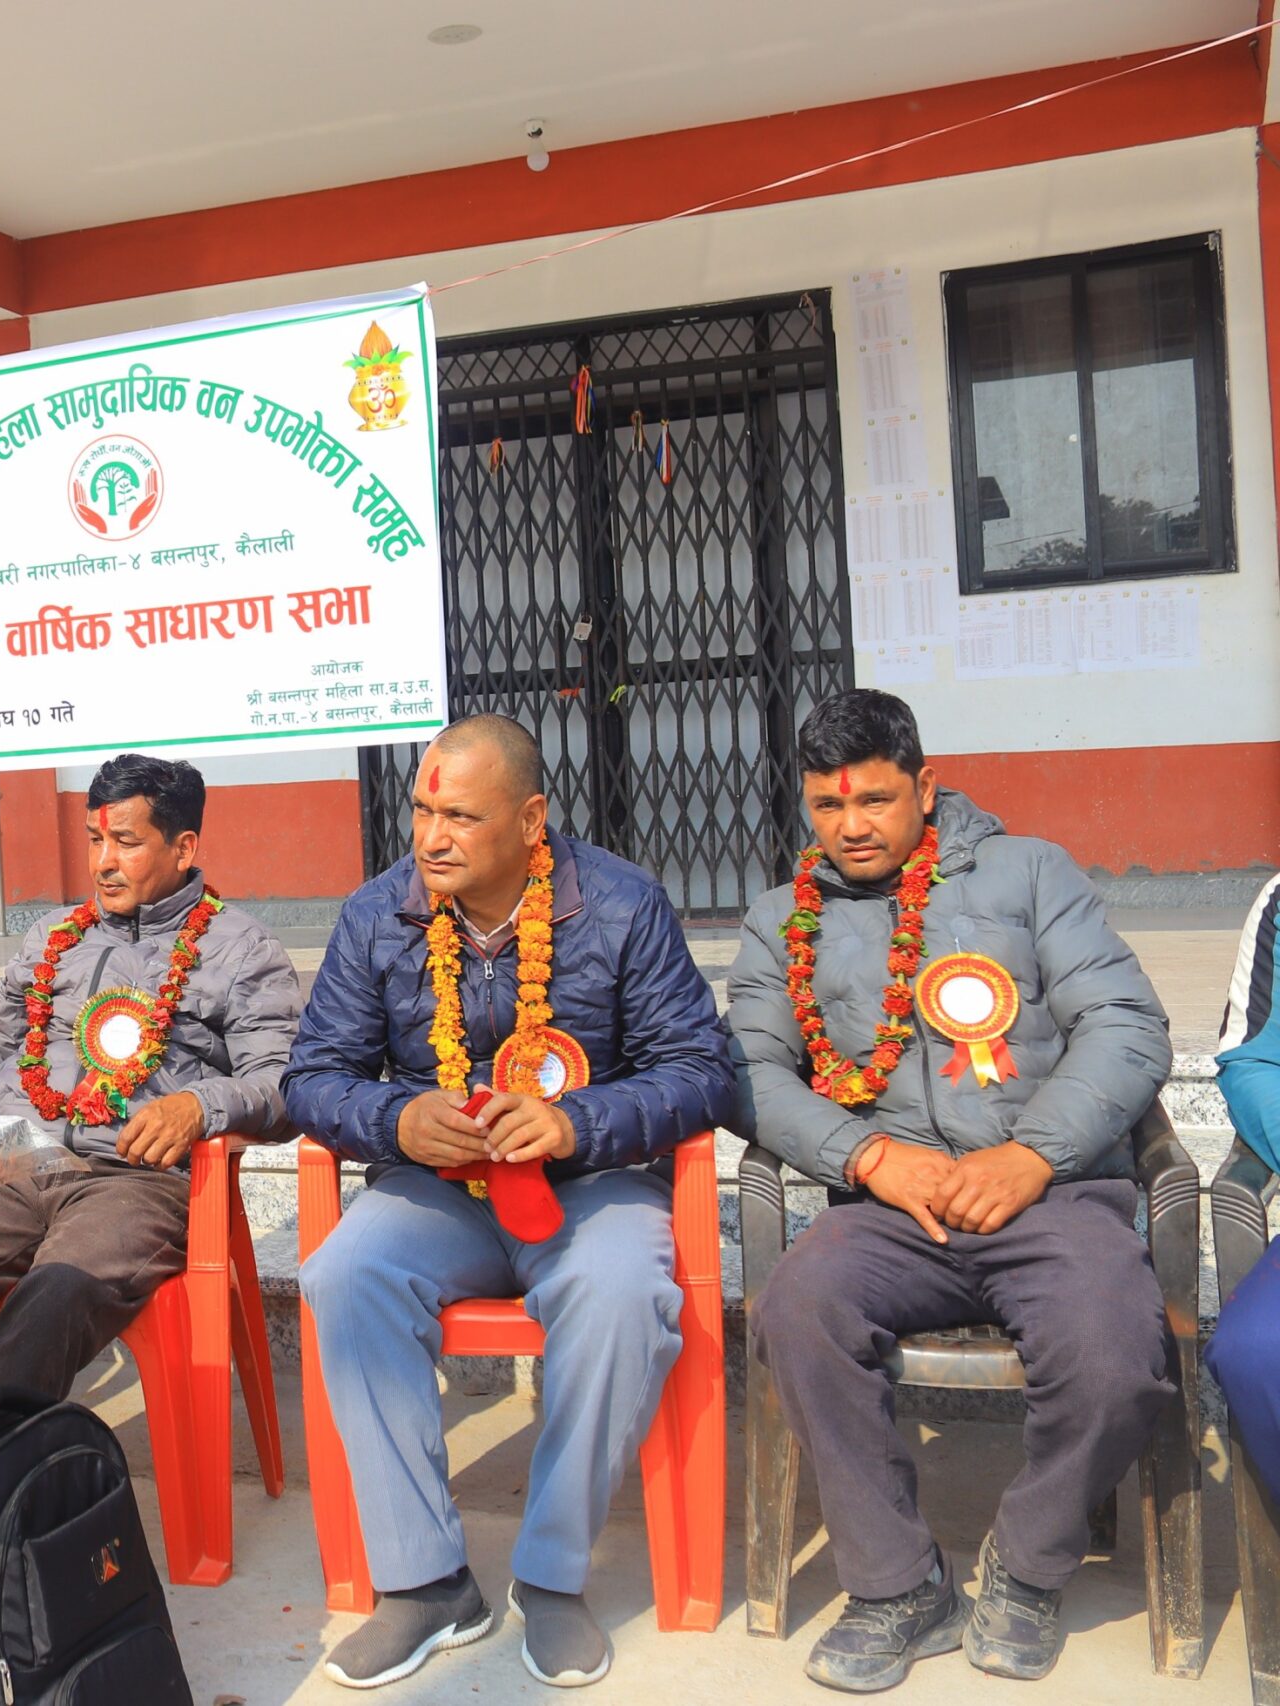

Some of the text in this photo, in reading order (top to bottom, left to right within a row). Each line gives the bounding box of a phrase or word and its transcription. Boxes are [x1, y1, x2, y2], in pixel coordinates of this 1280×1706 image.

[43, 362, 191, 431] सामुदायिक
[195, 379, 245, 425] वन
[243, 394, 363, 489] उपभोक्ता
[351, 472, 426, 563] समूह
[150, 543, 226, 568] बसन्तपुर,
[235, 529, 295, 557] कैलाली
[5, 604, 113, 657] वार्षिक
[124, 594, 274, 649] साधारण
[287, 584, 373, 633] सभा
[311, 659, 364, 677] आयोजक
[246, 689, 262, 706] श्री
[269, 687, 319, 706] बसन्तपुर
[325, 682, 363, 700] महिला
[390, 698, 433, 716] कैलाली
[22, 708, 41, 727] १०
[50, 700, 75, 723] गते
